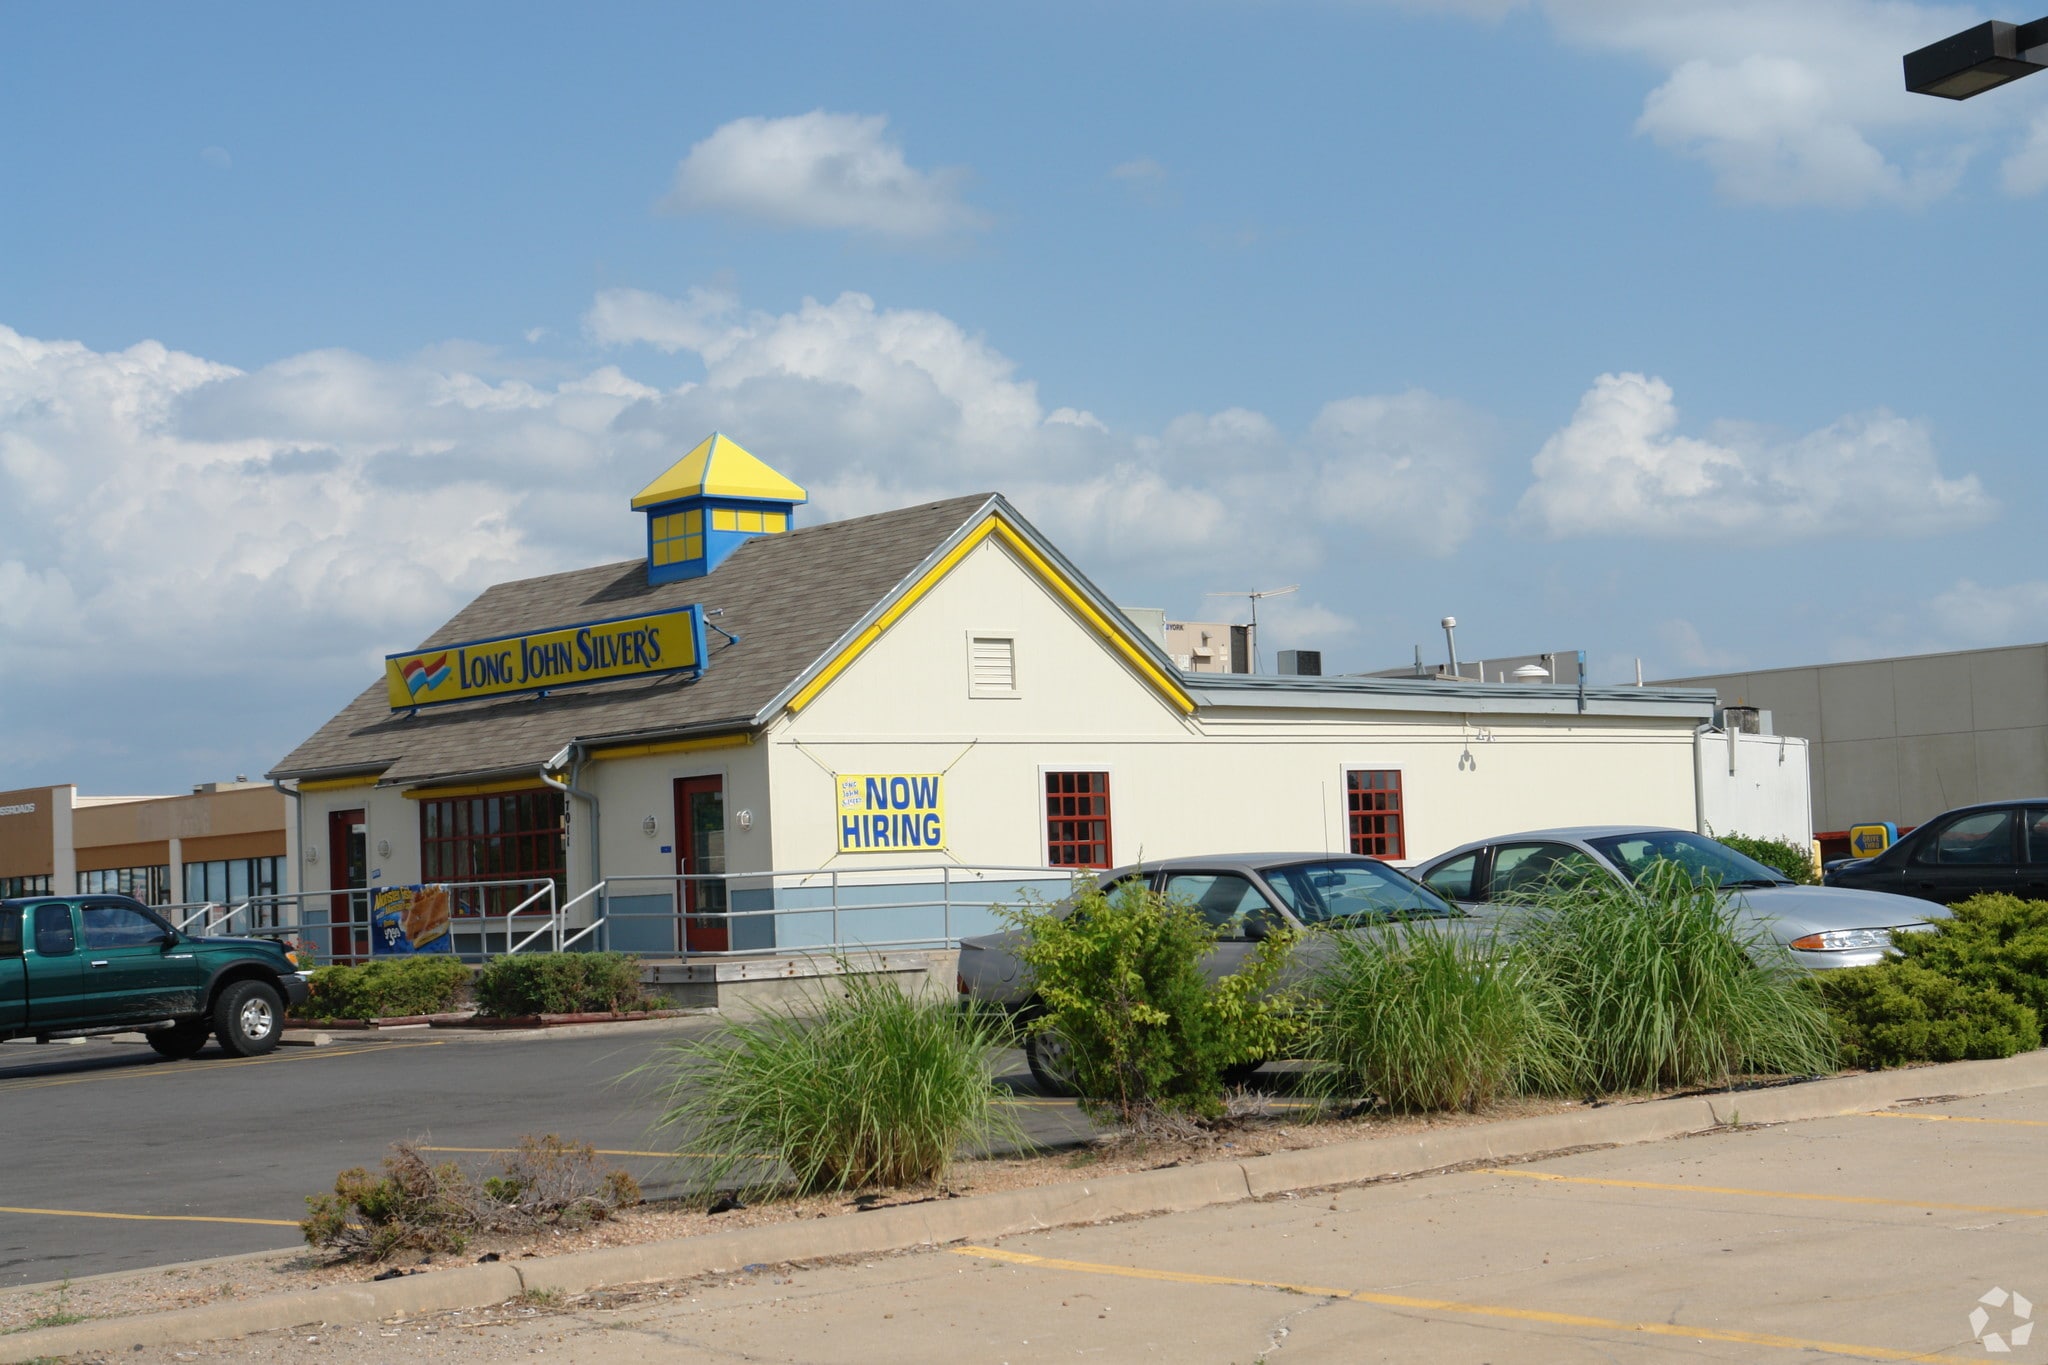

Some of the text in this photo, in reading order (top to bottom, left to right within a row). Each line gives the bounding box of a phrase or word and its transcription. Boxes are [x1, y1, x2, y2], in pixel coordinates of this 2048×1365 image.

[458, 624, 661, 690] LONG JOHN SILVER'S
[866, 777, 939, 810] NOW
[841, 813, 941, 848] HIRING
